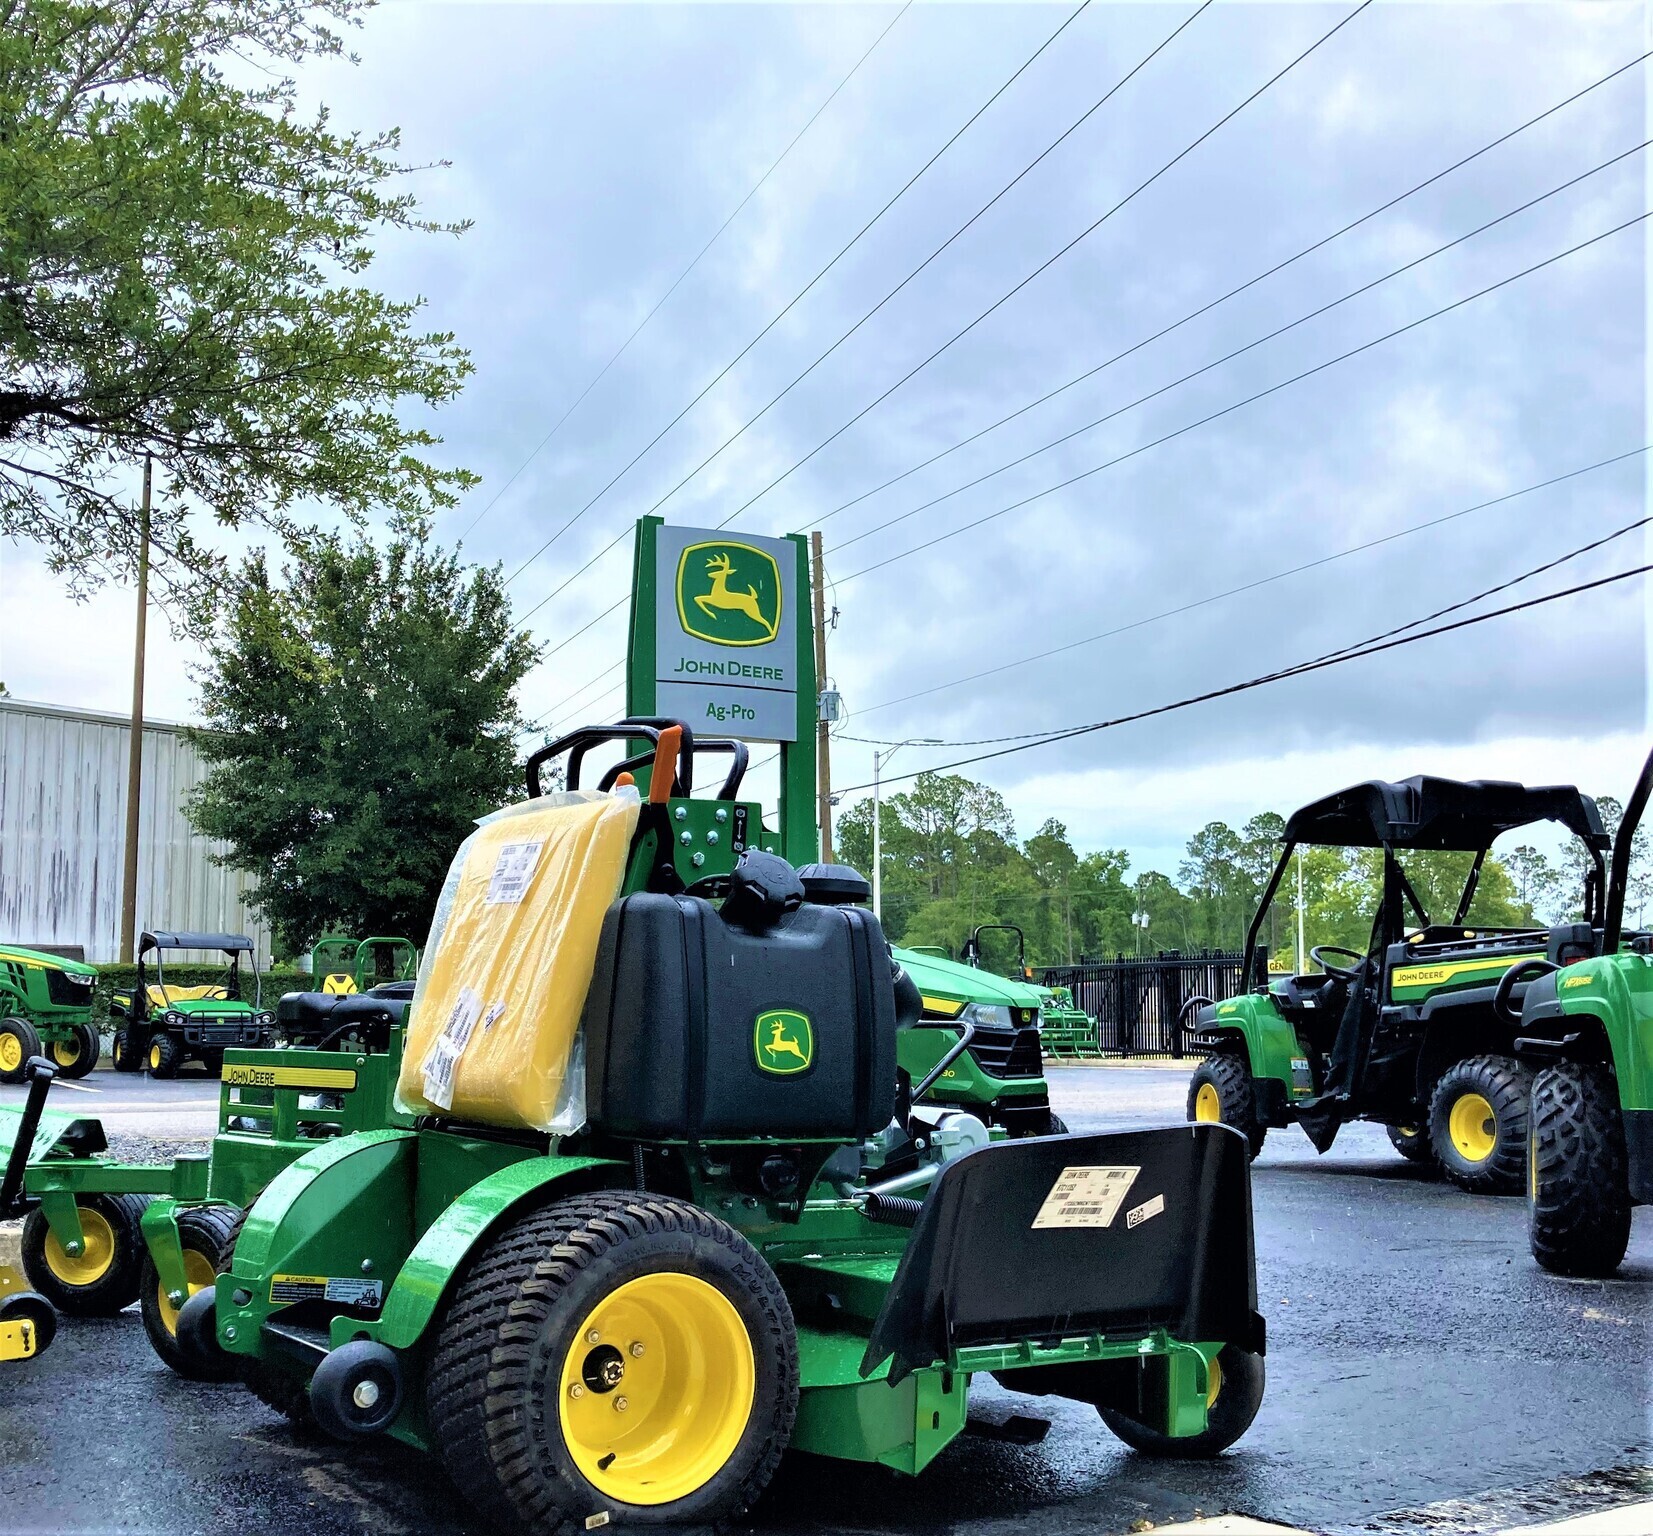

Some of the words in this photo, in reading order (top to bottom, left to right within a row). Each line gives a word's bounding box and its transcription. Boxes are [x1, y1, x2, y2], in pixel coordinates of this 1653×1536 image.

[674, 658, 727, 676] JOHN
[728, 661, 783, 681] DEERE
[706, 702, 755, 720] Ag-Pro
[1397, 973, 1417, 982] JOHN
[1418, 971, 1444, 980] DEERE
[228, 1068, 248, 1083] JOHN
[249, 1069, 275, 1085] DEERE
